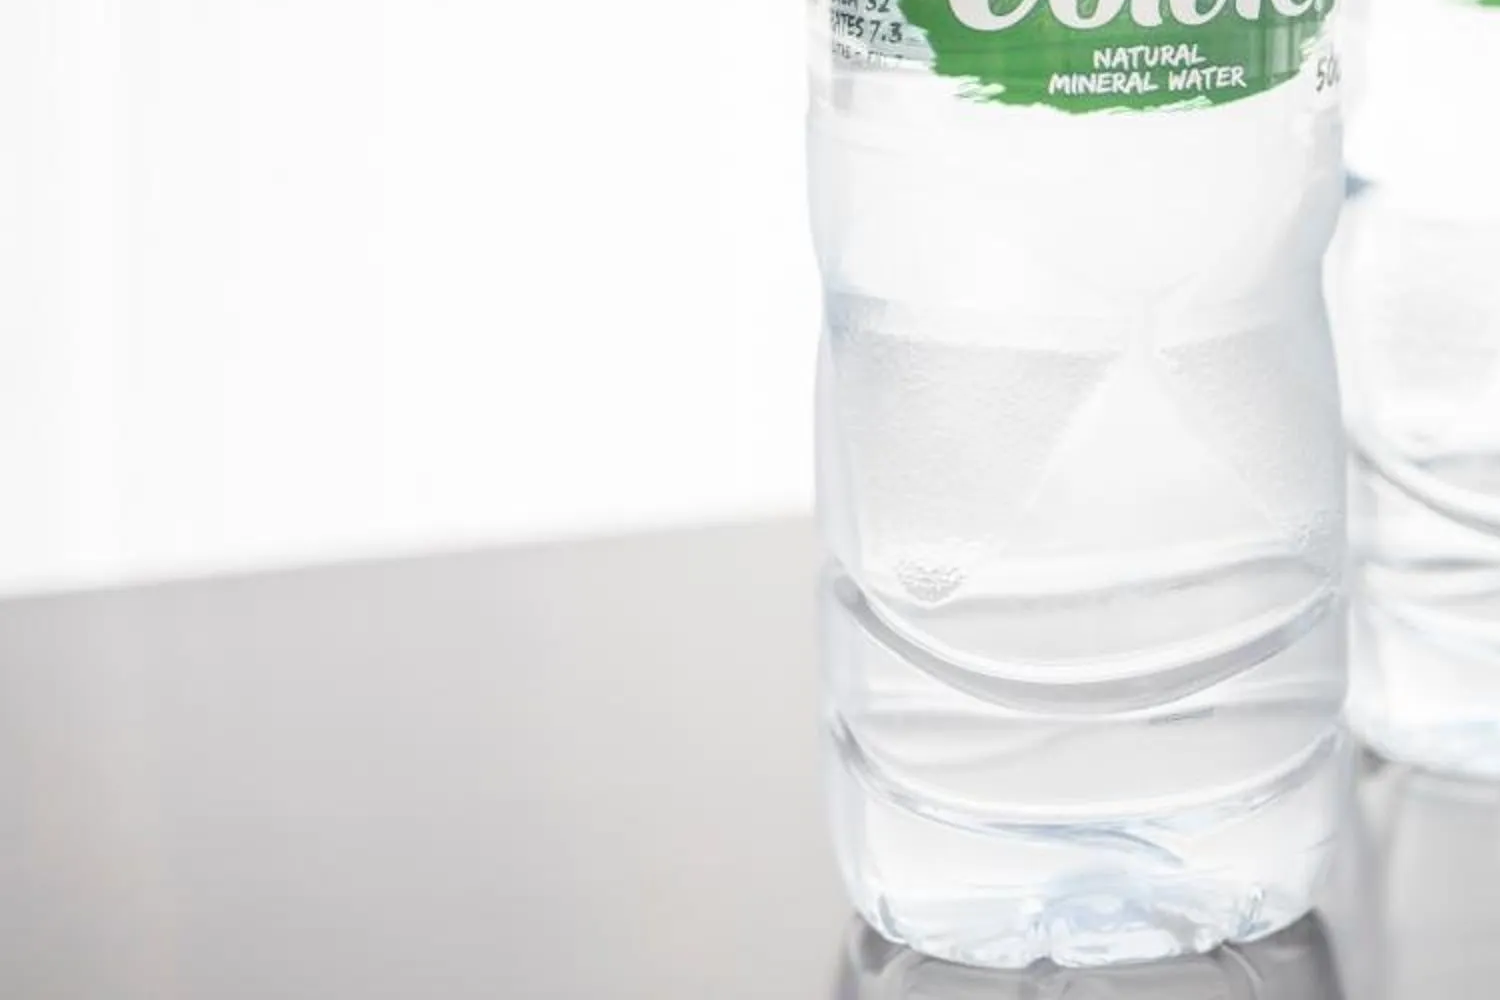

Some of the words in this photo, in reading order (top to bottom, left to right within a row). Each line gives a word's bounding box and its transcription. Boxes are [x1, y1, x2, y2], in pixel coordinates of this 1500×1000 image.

[869, 20, 903, 43] 7.3
[1092, 43, 1207, 71] NATURAL
[1048, 71, 1159, 95] MINERAL
[1168, 65, 1248, 91] WATER
